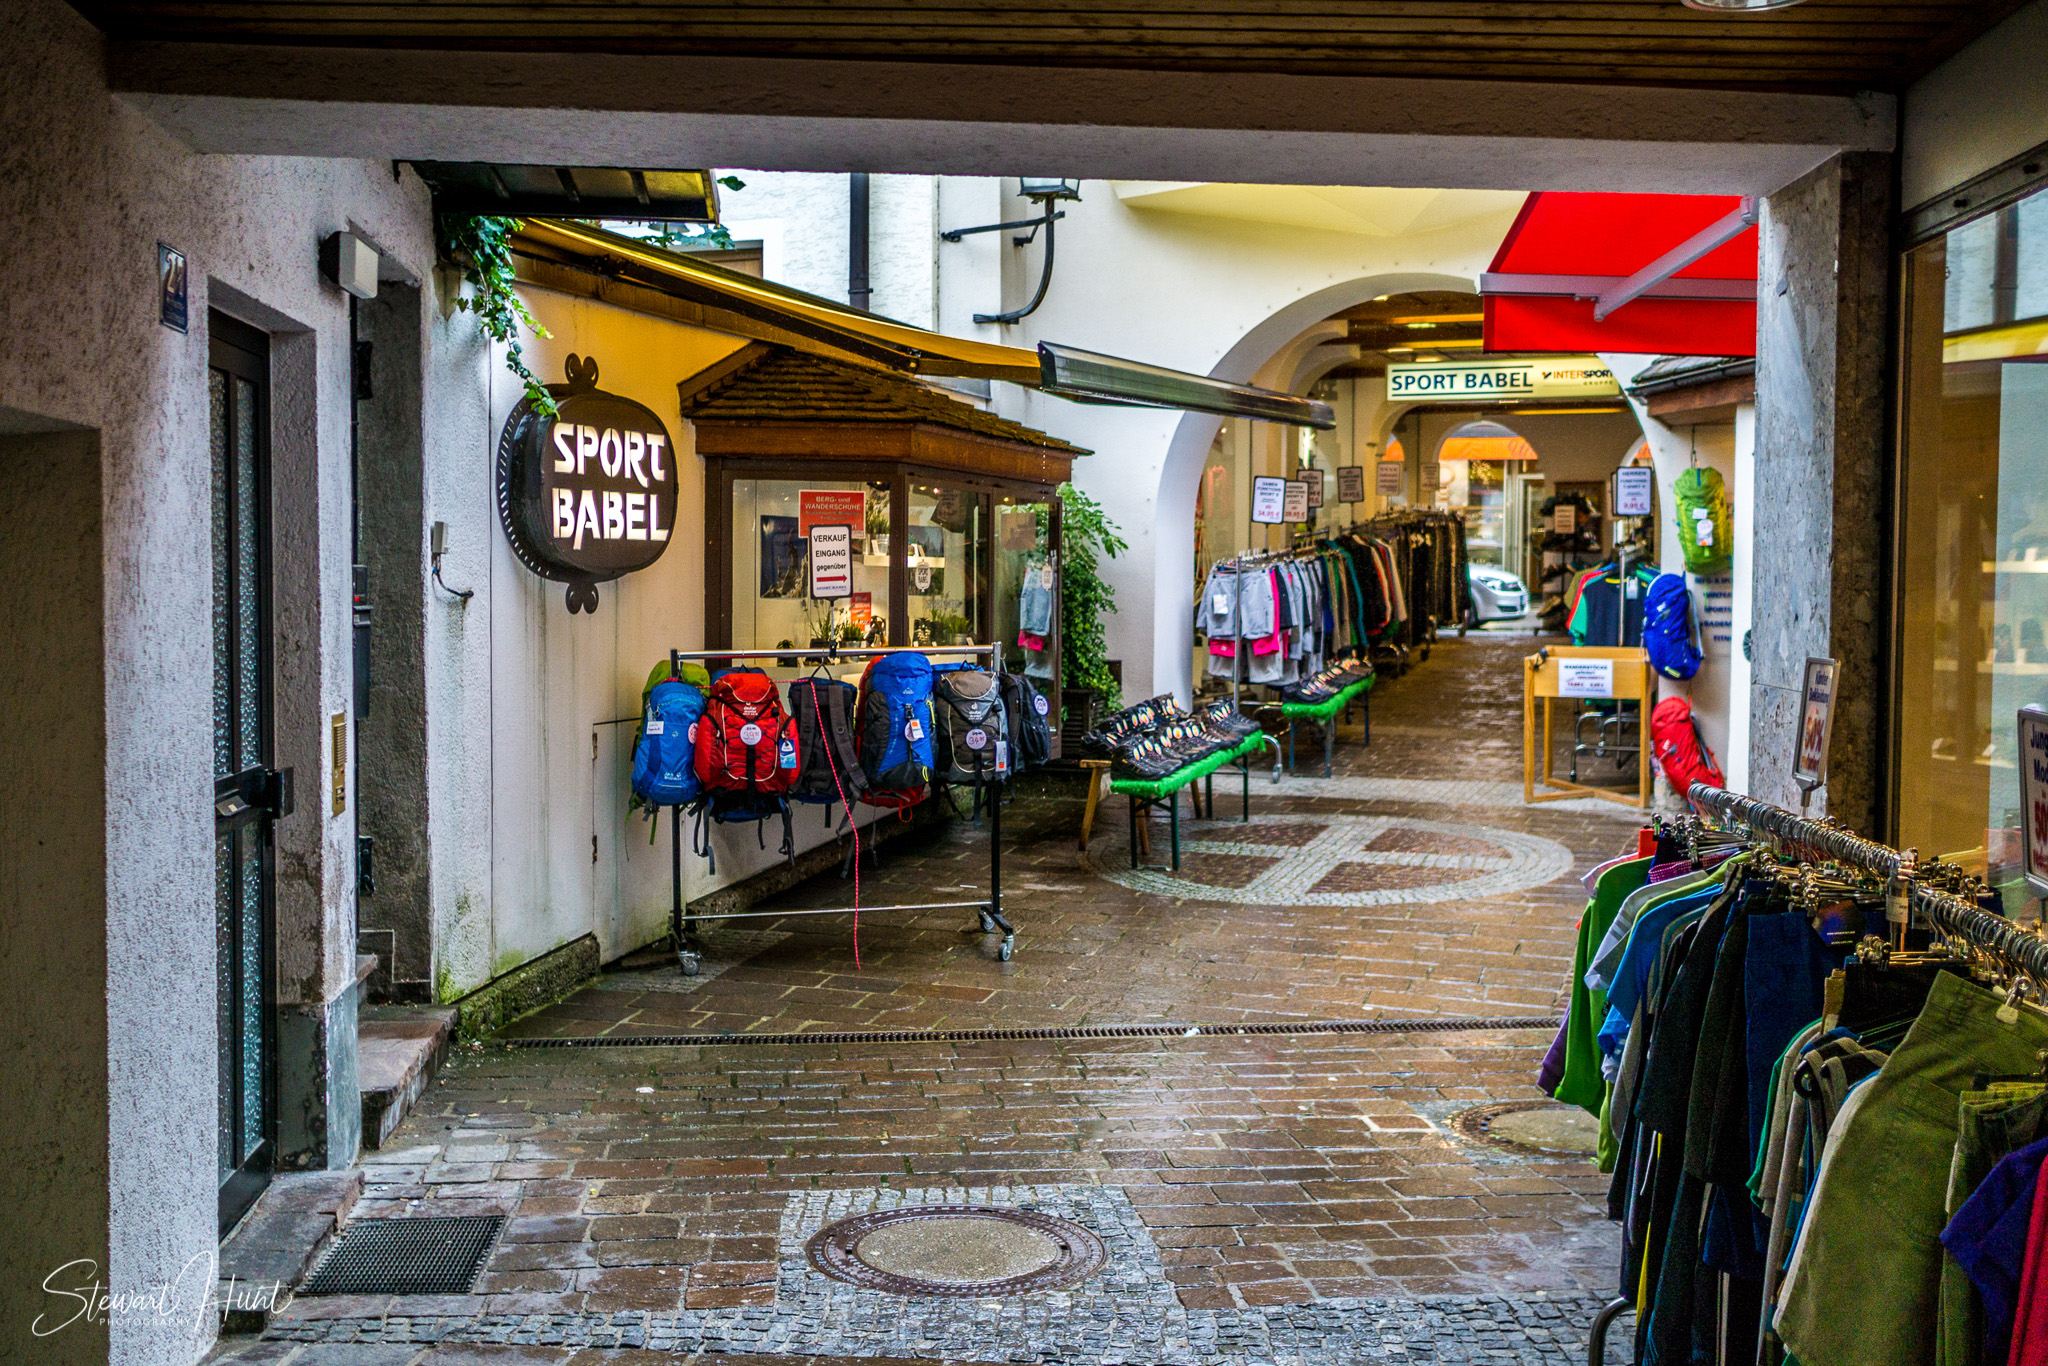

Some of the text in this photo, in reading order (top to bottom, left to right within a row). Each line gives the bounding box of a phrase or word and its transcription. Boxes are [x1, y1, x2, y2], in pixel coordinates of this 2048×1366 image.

[1553, 369, 1613, 379] INTERSPORT
[1391, 372, 1534, 391] SPORT BABEL
[553, 422, 665, 488] SPORT
[805, 503, 861, 511] WANDERSCHUHE
[551, 487, 669, 550] BABEL
[813, 534, 847, 543] VERKAUF
[815, 549, 846, 558] EINGANG
[816, 563, 847, 572] gegenüber
